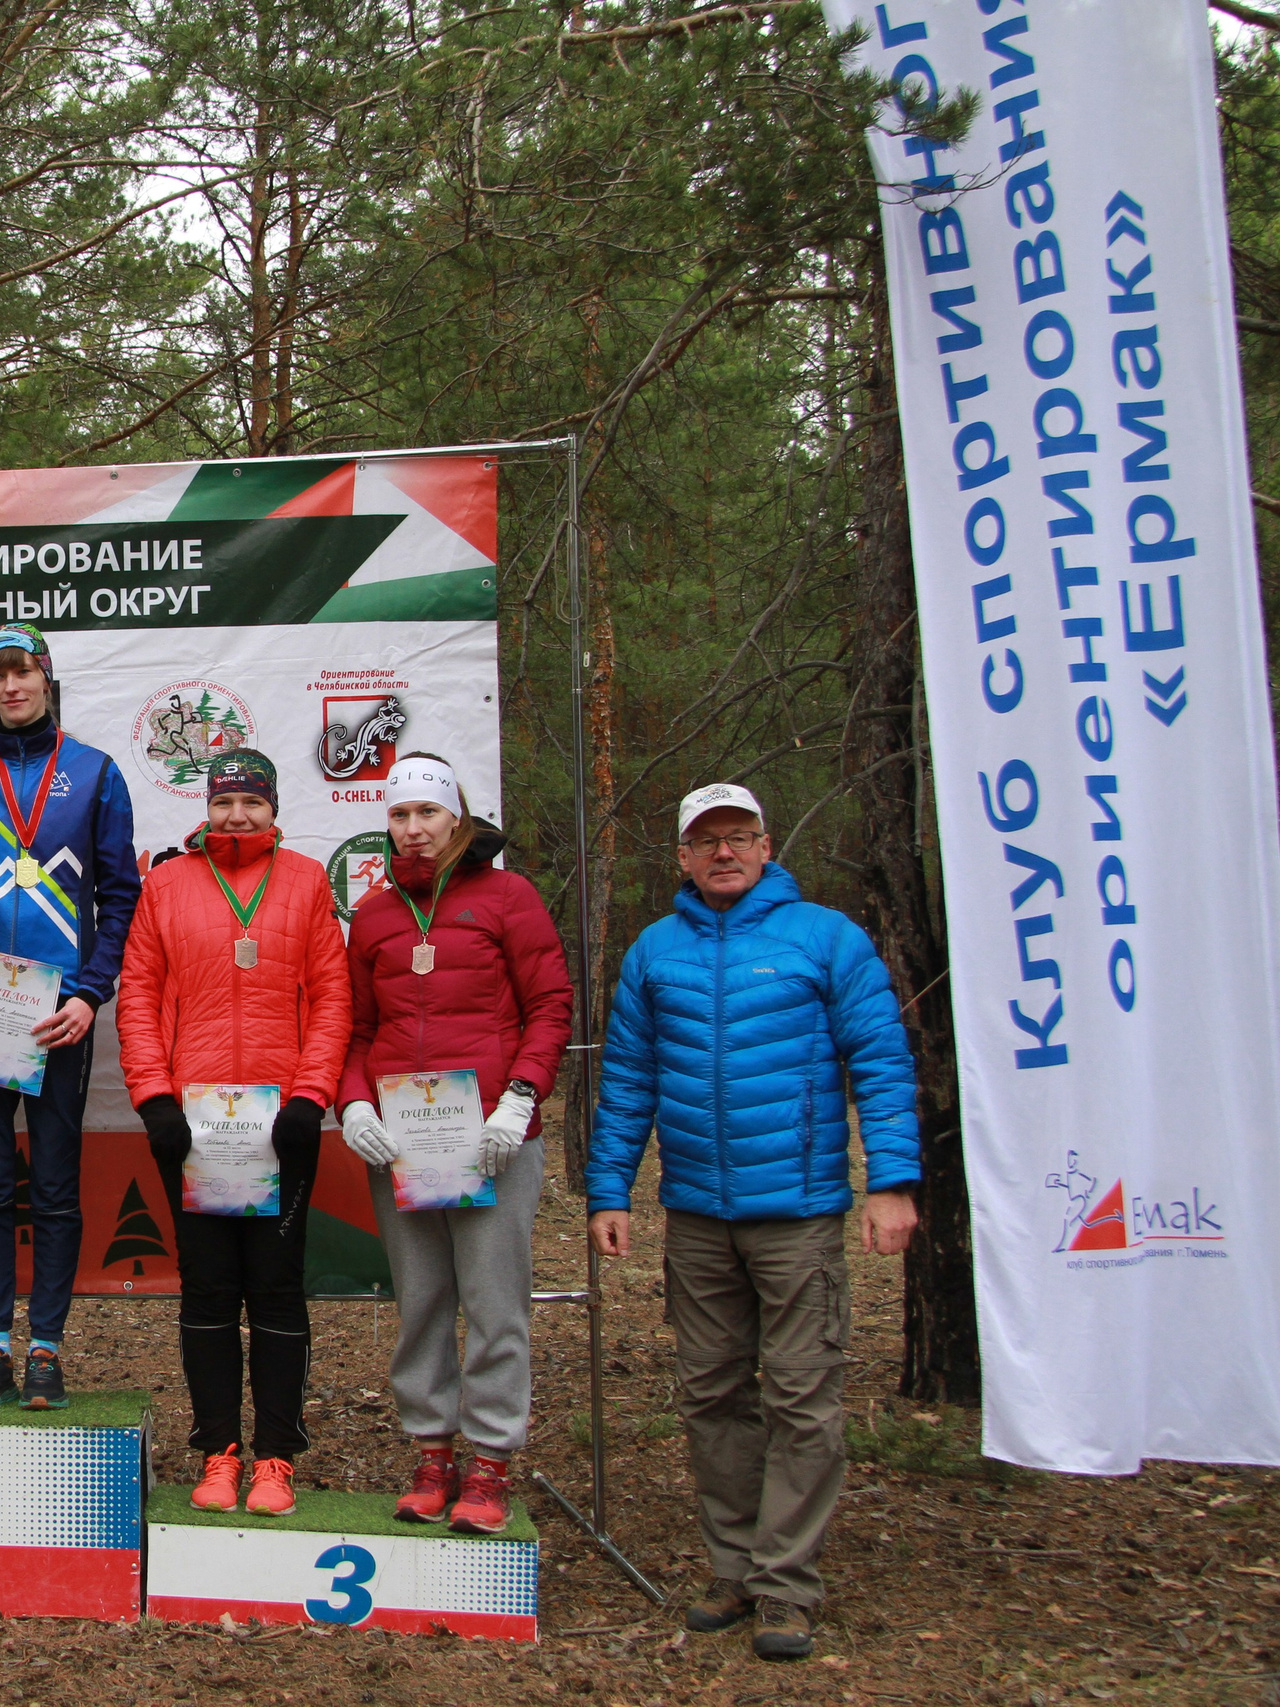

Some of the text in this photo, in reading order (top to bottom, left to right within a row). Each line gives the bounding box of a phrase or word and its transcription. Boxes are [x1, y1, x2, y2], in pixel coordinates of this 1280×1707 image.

[1104, 190, 1196, 727] «Ермак»
[975, 0, 1137, 1013] ориентировани
[90, 585, 211, 618] ОКРУГ
[314, 680, 370, 690] Челябинской
[372, 679, 409, 689] области
[320, 670, 395, 680] Ориентирование
[133, 681, 255, 740] ФЕДЕРАЦИЯ СПОРТИВНОГО ОРИЕНТИРОВАНИЯ
[154, 779, 201, 798] КУРГАНСКОЙ
[330, 845, 352, 882] ФЕДЕРАЦИЯ
[331, 888, 352, 917] ОБЛАСТИ
[977, 759, 1069, 1070] Клуб
[199, 1120, 264, 1131] ДИПЛОМ
[398, 1105, 465, 1119] ДИПЛОМ
[304, 1544, 377, 1626] 3
